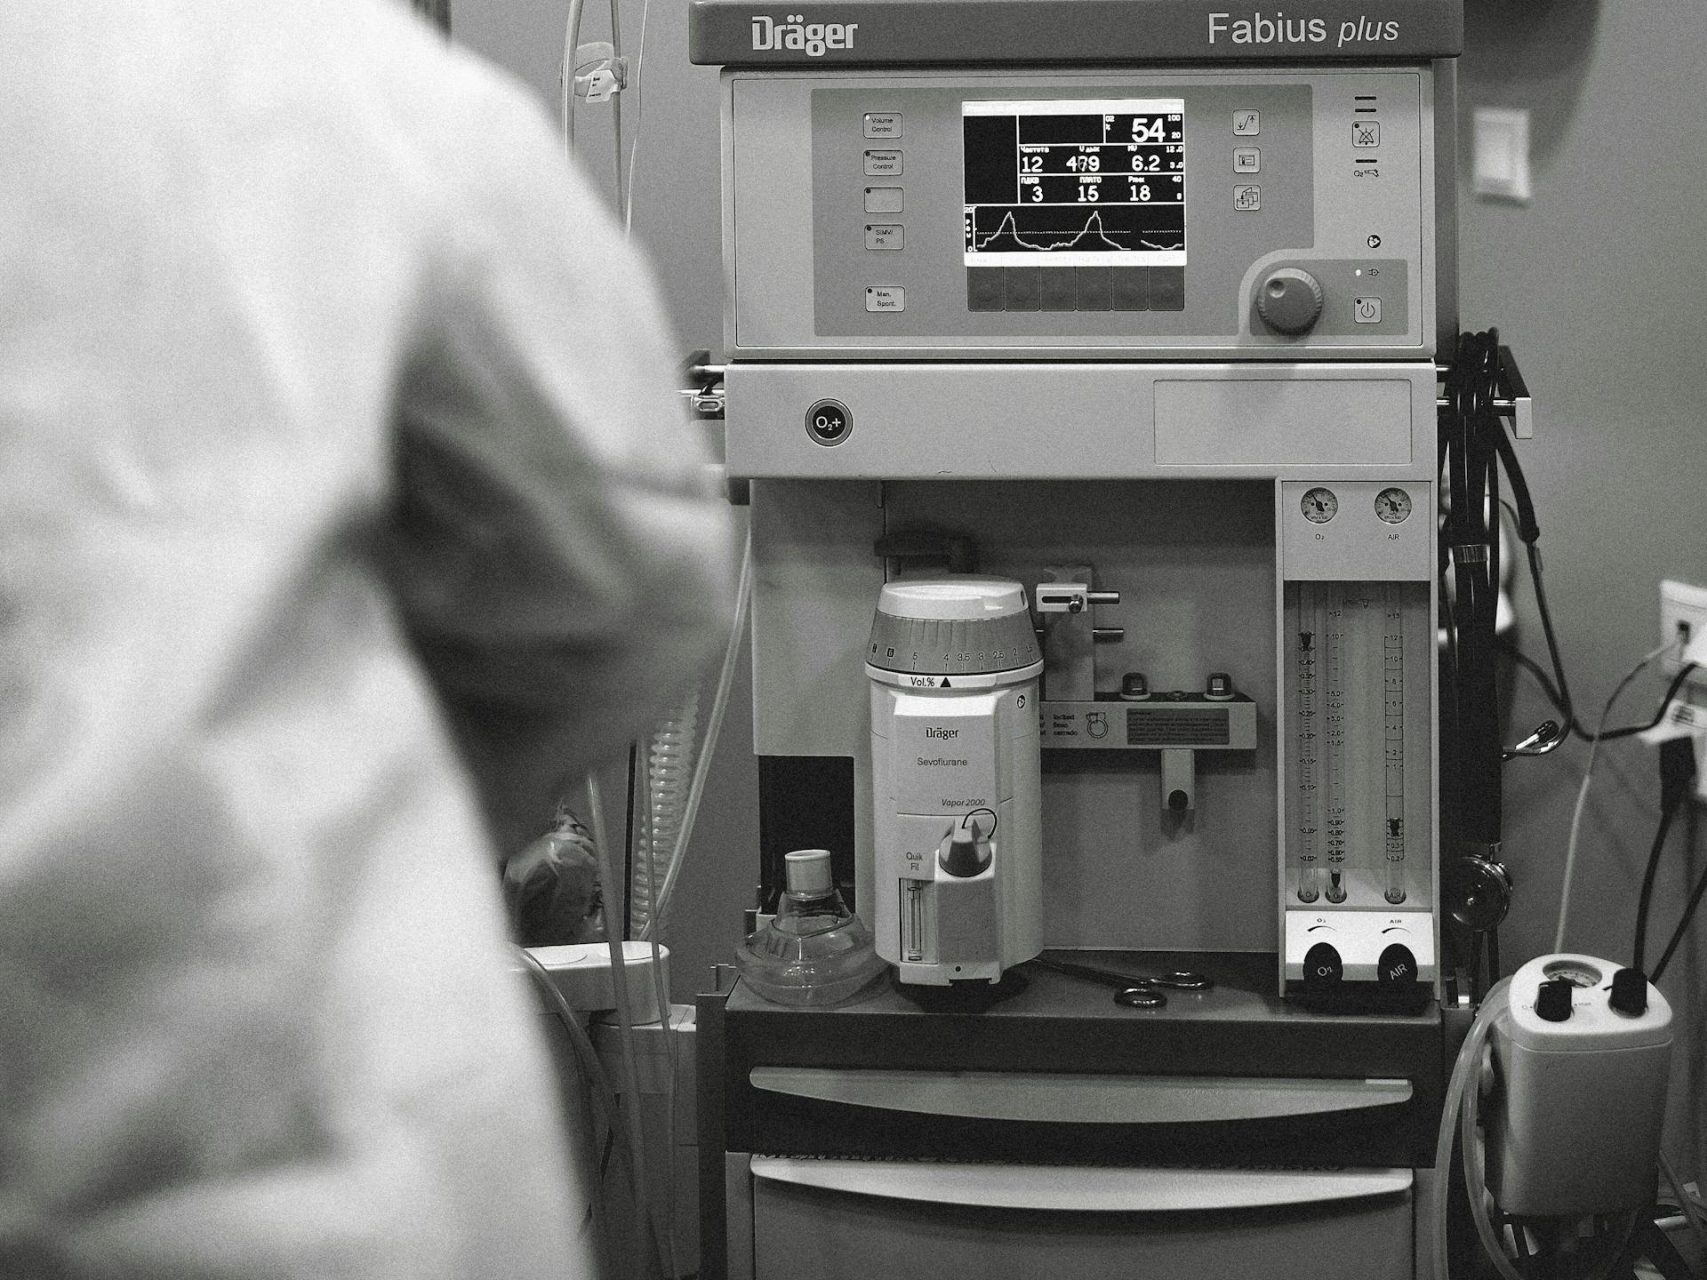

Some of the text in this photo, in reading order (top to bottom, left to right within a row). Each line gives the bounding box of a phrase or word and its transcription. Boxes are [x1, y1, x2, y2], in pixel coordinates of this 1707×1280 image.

[752, 14, 858, 57] Dräger
[1208, 13, 1400, 46] Fabius plus
[1131, 117, 1166, 143] 54
[1167, 114, 1181, 122] 100
[1021, 155, 1160, 172] 12 479 6.2
[1032, 185, 1151, 203] 3 15 18
[912, 652, 918, 660] 5
[943, 654, 949, 662] 4
[957, 653, 971, 662] 3.5
[978, 652, 984, 660] 3
[911, 676, 935, 687] Vol.%
[926, 727, 959, 741] Dräger
[917, 757, 968, 766] Sevoflurane
[941, 798, 986, 807] Vapor 2000
[906, 851, 923, 862] Quik
[1317, 966, 1333, 977] O2
[1389, 963, 1408, 980] AIR
